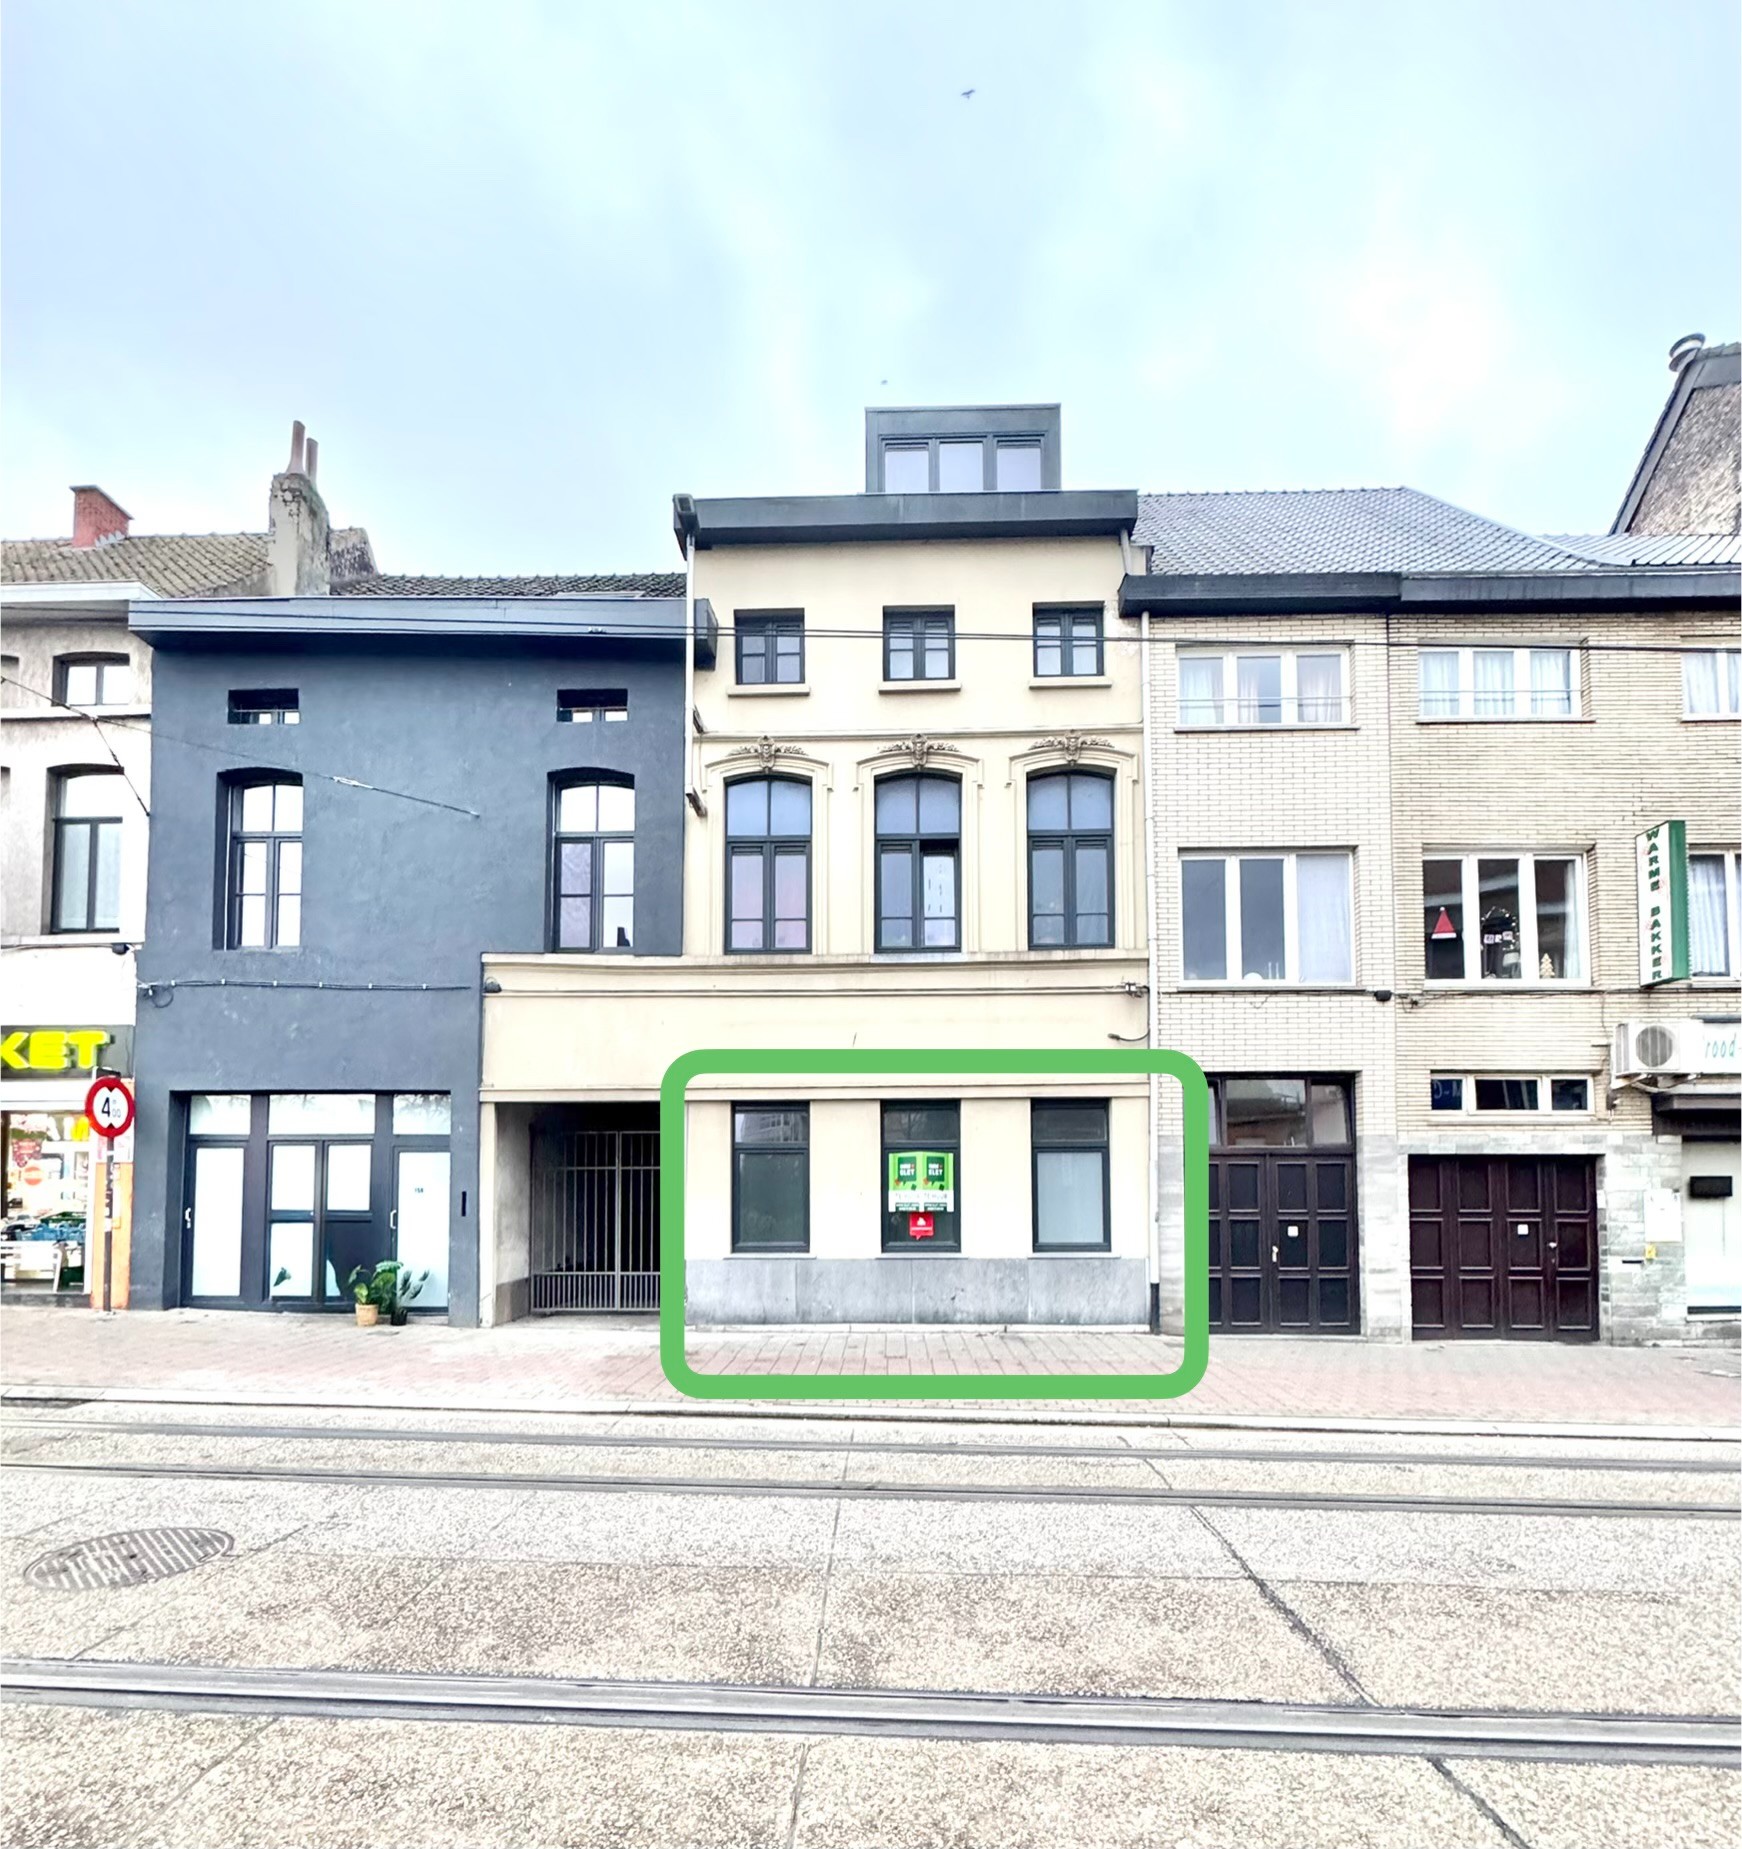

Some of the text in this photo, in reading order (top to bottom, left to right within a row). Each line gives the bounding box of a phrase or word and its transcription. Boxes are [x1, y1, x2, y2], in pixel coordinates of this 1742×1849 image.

[1646, 828, 1663, 980] WARME BAKKER
[1, 1030, 108, 1070] KET
